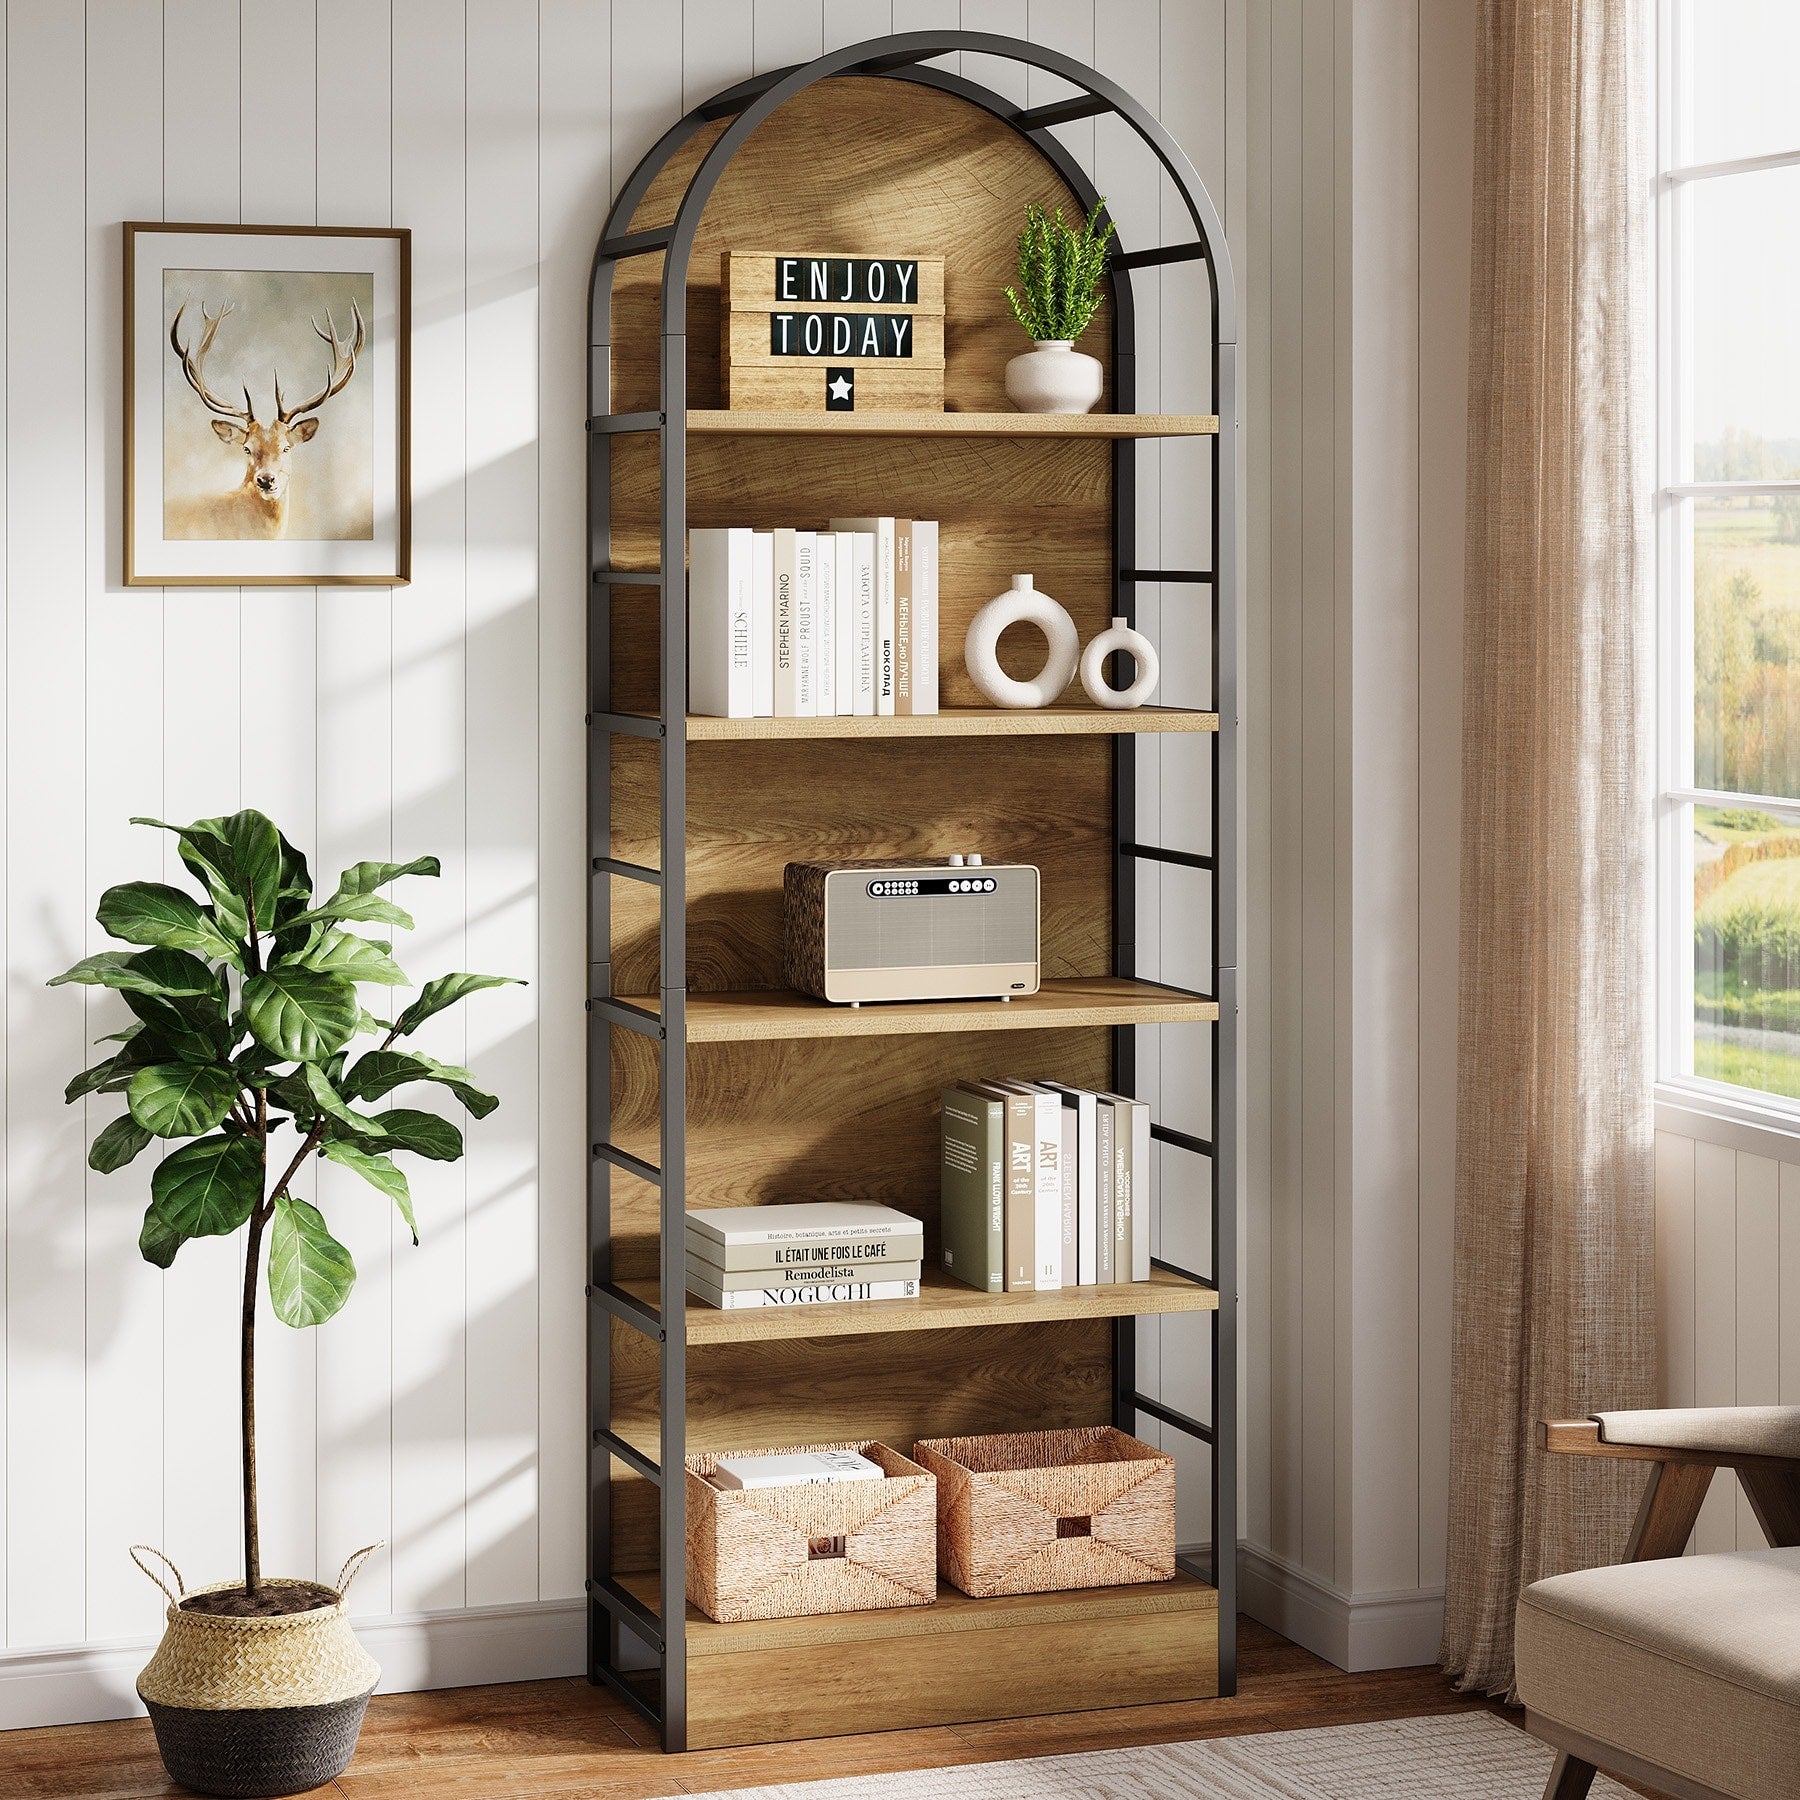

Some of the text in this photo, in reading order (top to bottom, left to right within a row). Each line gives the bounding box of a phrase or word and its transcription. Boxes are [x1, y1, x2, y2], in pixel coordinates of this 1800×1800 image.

[782, 260, 914, 303] ENJOY
[776, 314, 909, 356] TODAY
[800, 547, 811, 578] SQUID
[861, 564, 871, 606] ЗАБОТА
[734, 612, 748, 668] SCHIELE
[779, 573, 790, 669] STEPHEN MARINO
[800, 601, 811, 640] PROUST
[861, 622, 871, 693] ПРЕДАННЫХ
[882, 639, 891, 696] ШОКОЛАД
[898, 660, 909, 698] ЛУЧШЕ
[1012, 1141, 1031, 1173] ART
[1040, 1141, 1058, 1170] ART
[992, 1161, 1001, 1232] FRANK LLOYD WRIGHT
[775, 1241, 887, 1263] IL ÉTAIT UNE FOIS LE CAFÉ
[796, 1231, 827, 1239] botanique,
[850, 1228, 868, 1236] petits
[784, 1266, 855, 1281] Remodelista
[762, 1283, 871, 1305] NOGUCHI
